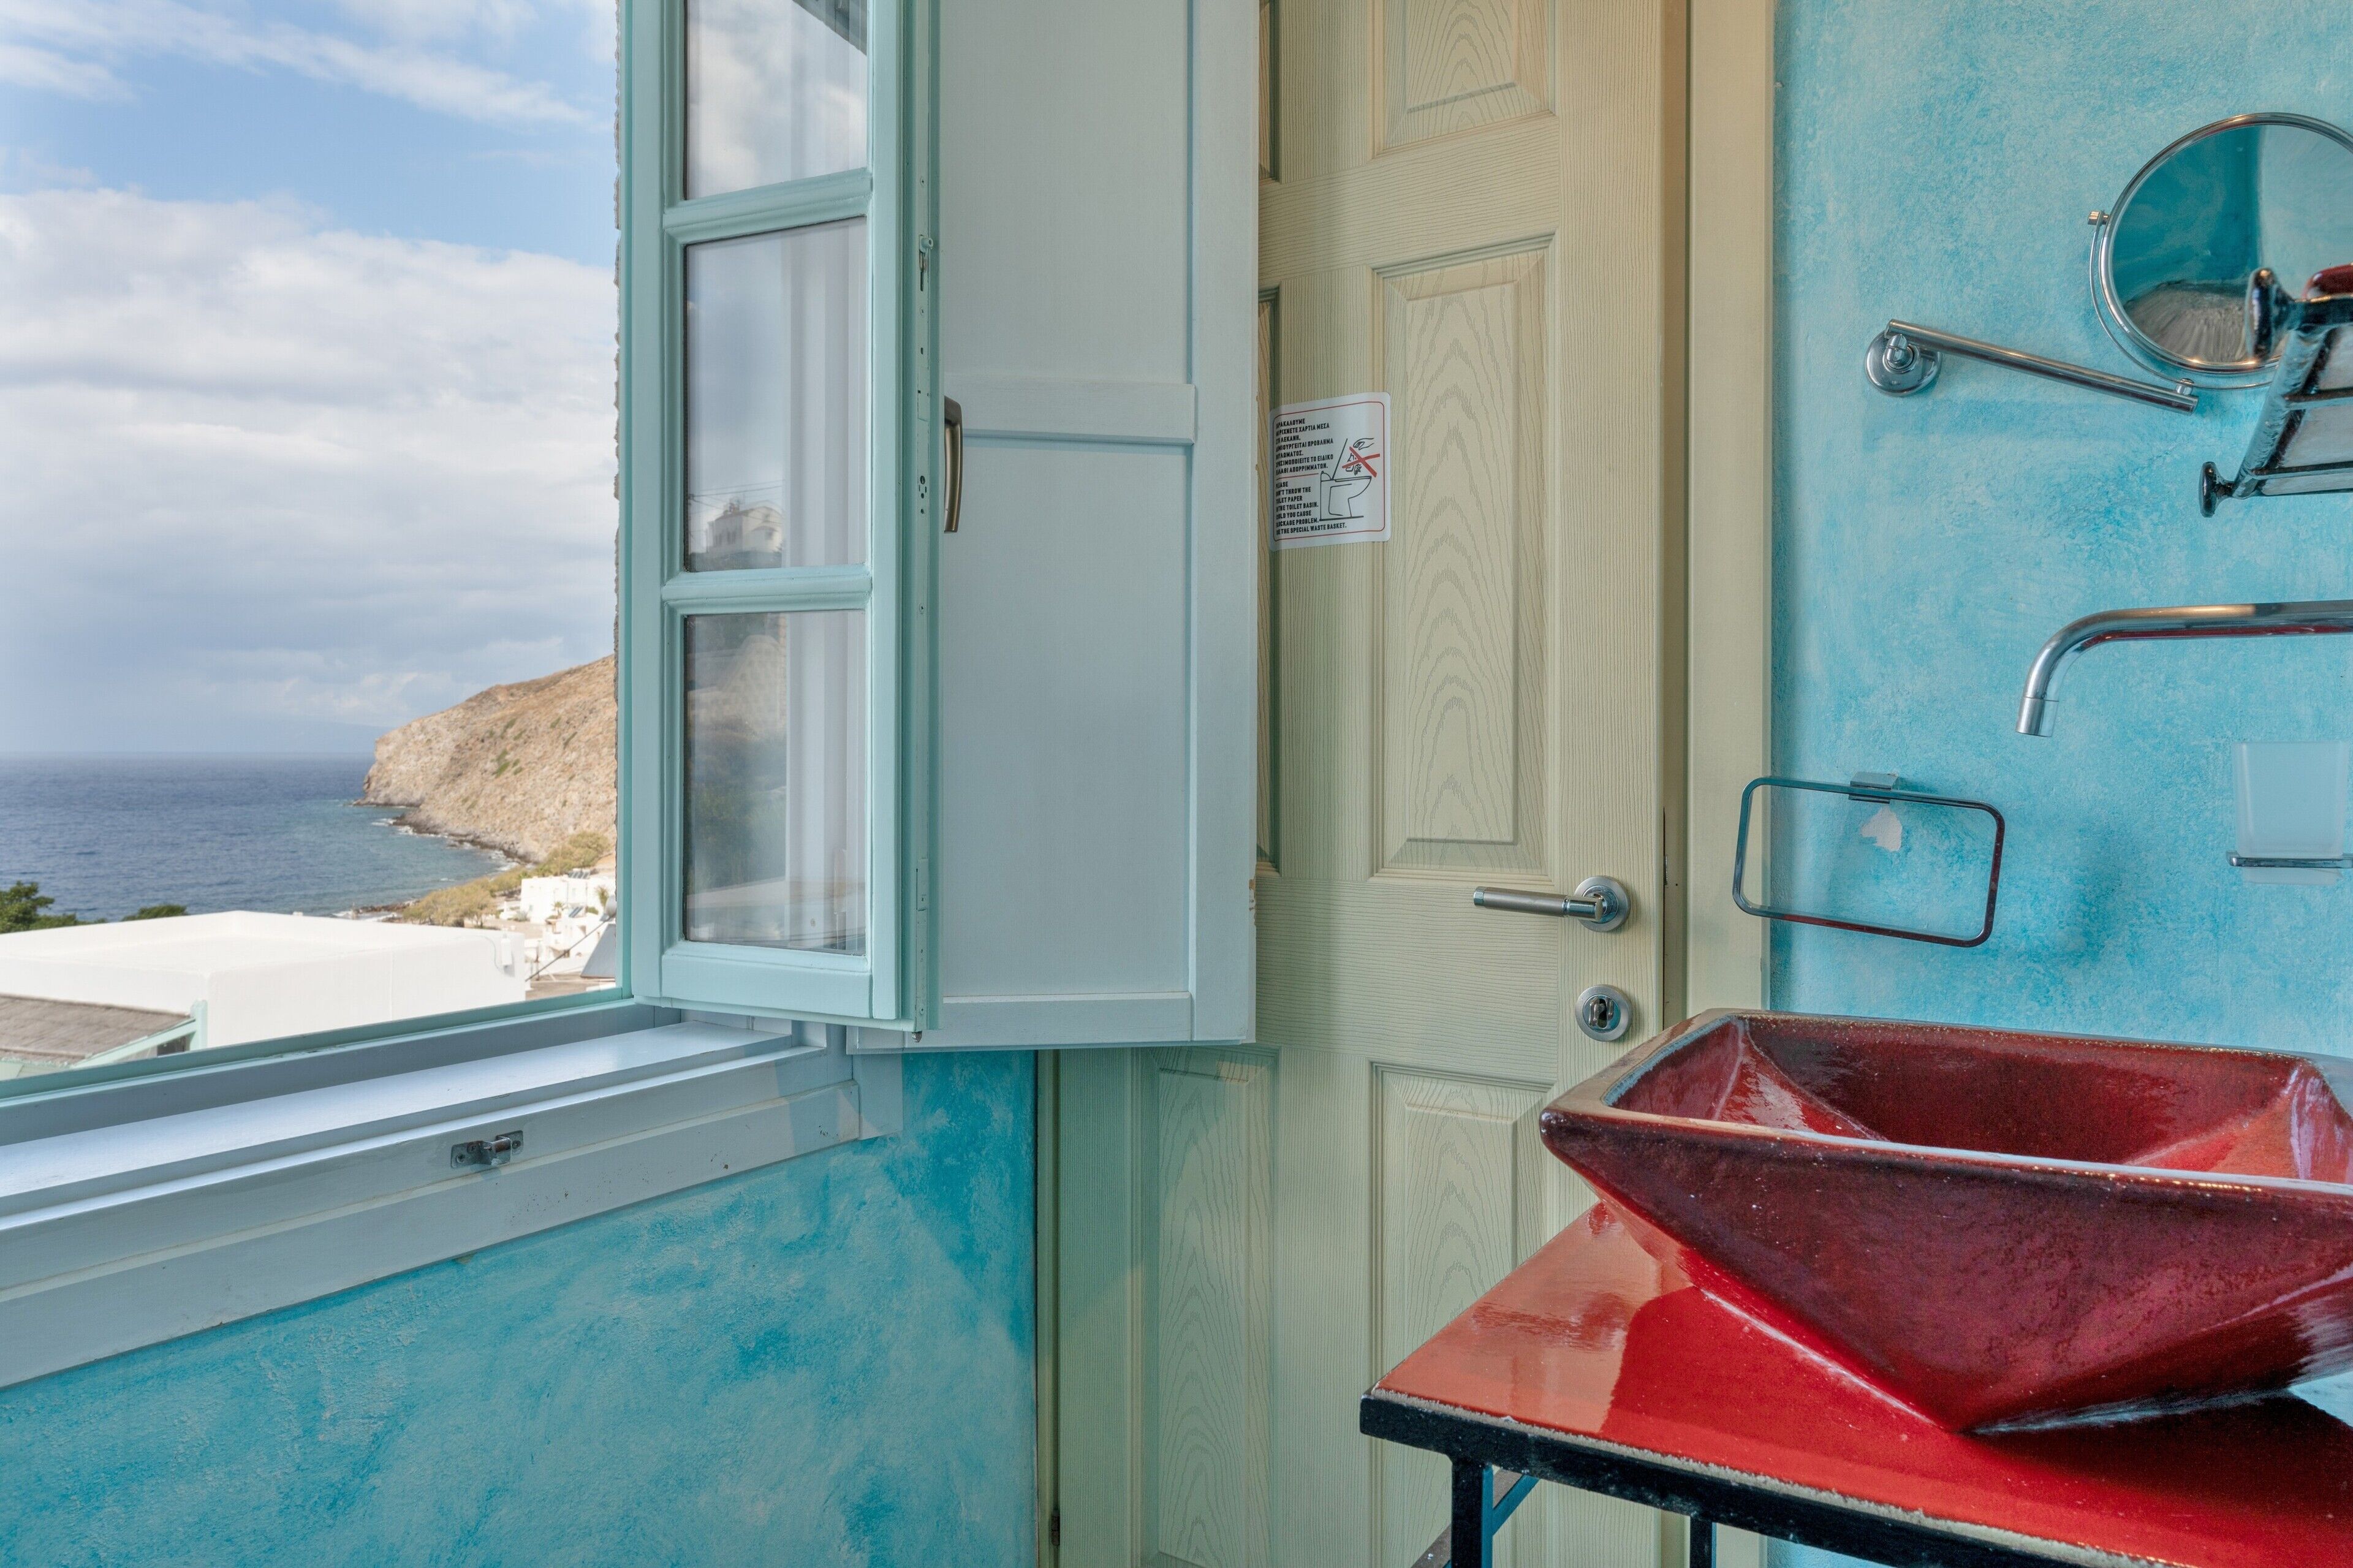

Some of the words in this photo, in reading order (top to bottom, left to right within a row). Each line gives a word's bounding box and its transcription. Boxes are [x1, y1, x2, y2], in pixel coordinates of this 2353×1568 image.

[1276, 419, 1305, 428] ΡΑΚΑΛΟΥΜΕ
[1276, 442, 1306, 452] ΜΙΟΥΡΓΕΙΤΑΙ
[1308, 438, 1333, 447] ΠΡΟΒΛΗΜΑ
